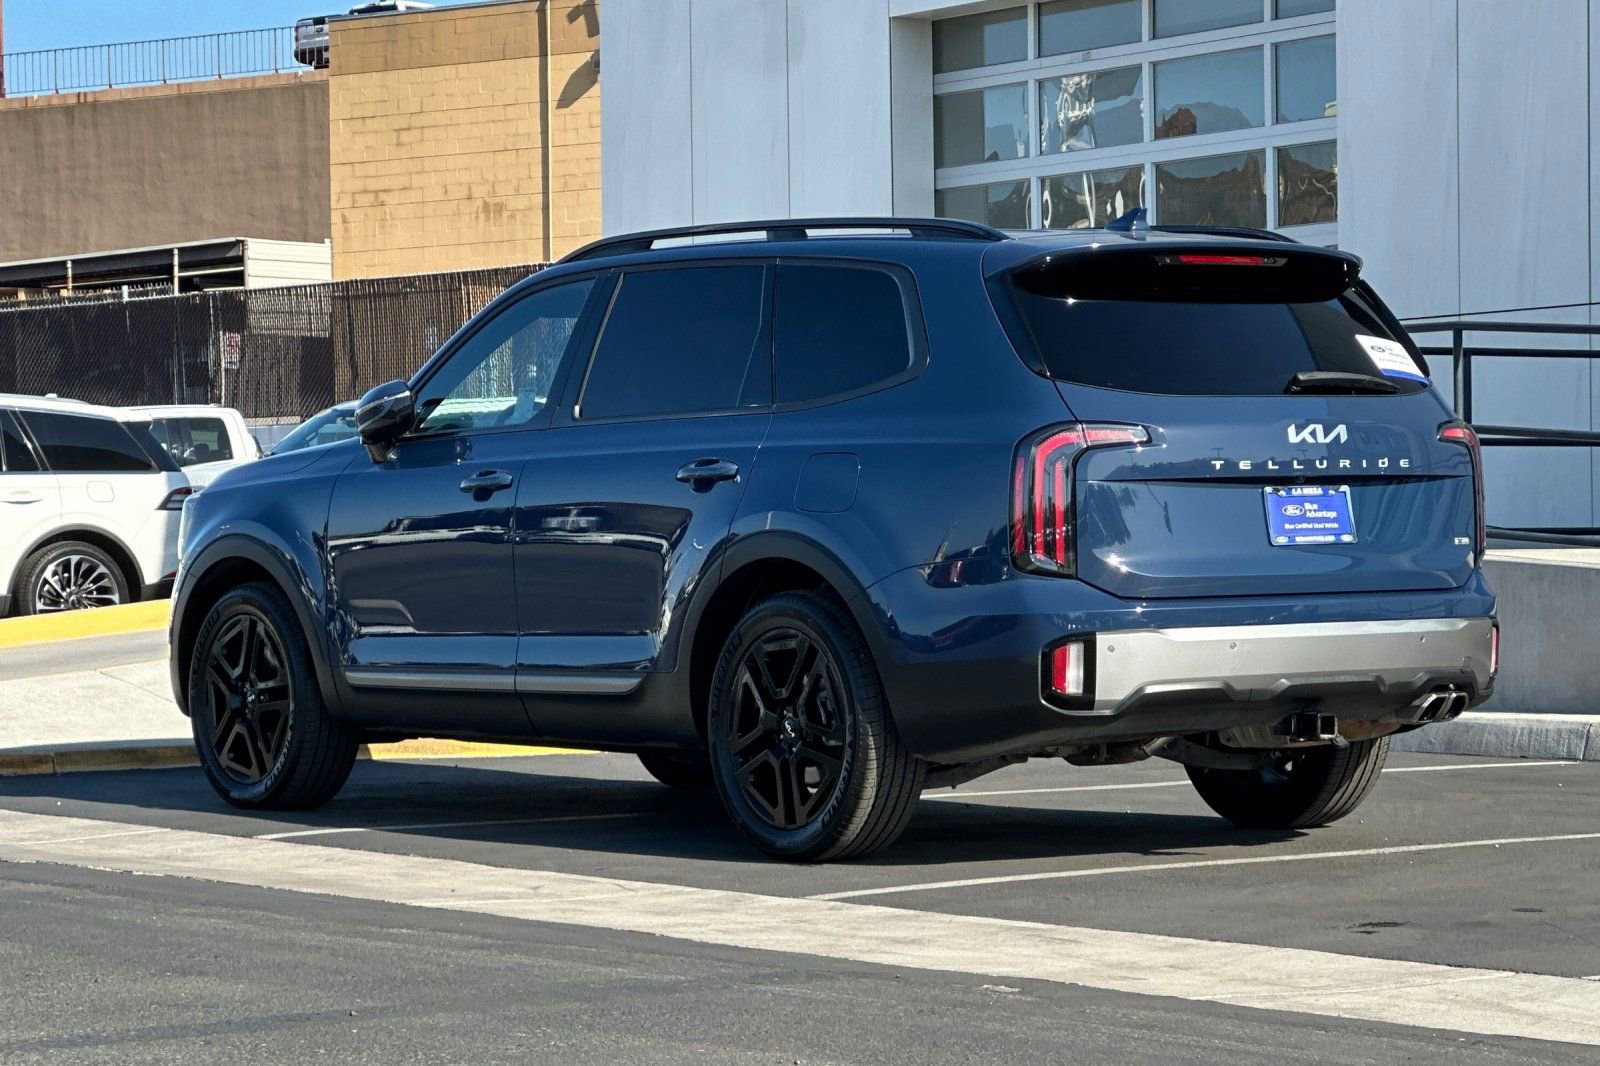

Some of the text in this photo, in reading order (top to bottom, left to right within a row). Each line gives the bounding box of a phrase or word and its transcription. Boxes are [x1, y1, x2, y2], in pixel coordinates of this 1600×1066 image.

[1287, 423, 1348, 444] KIA
[1211, 457, 1410, 470] TELLURIDE
[1304, 502, 1318, 510] Blue
[1306, 511, 1337, 519] Advantage
